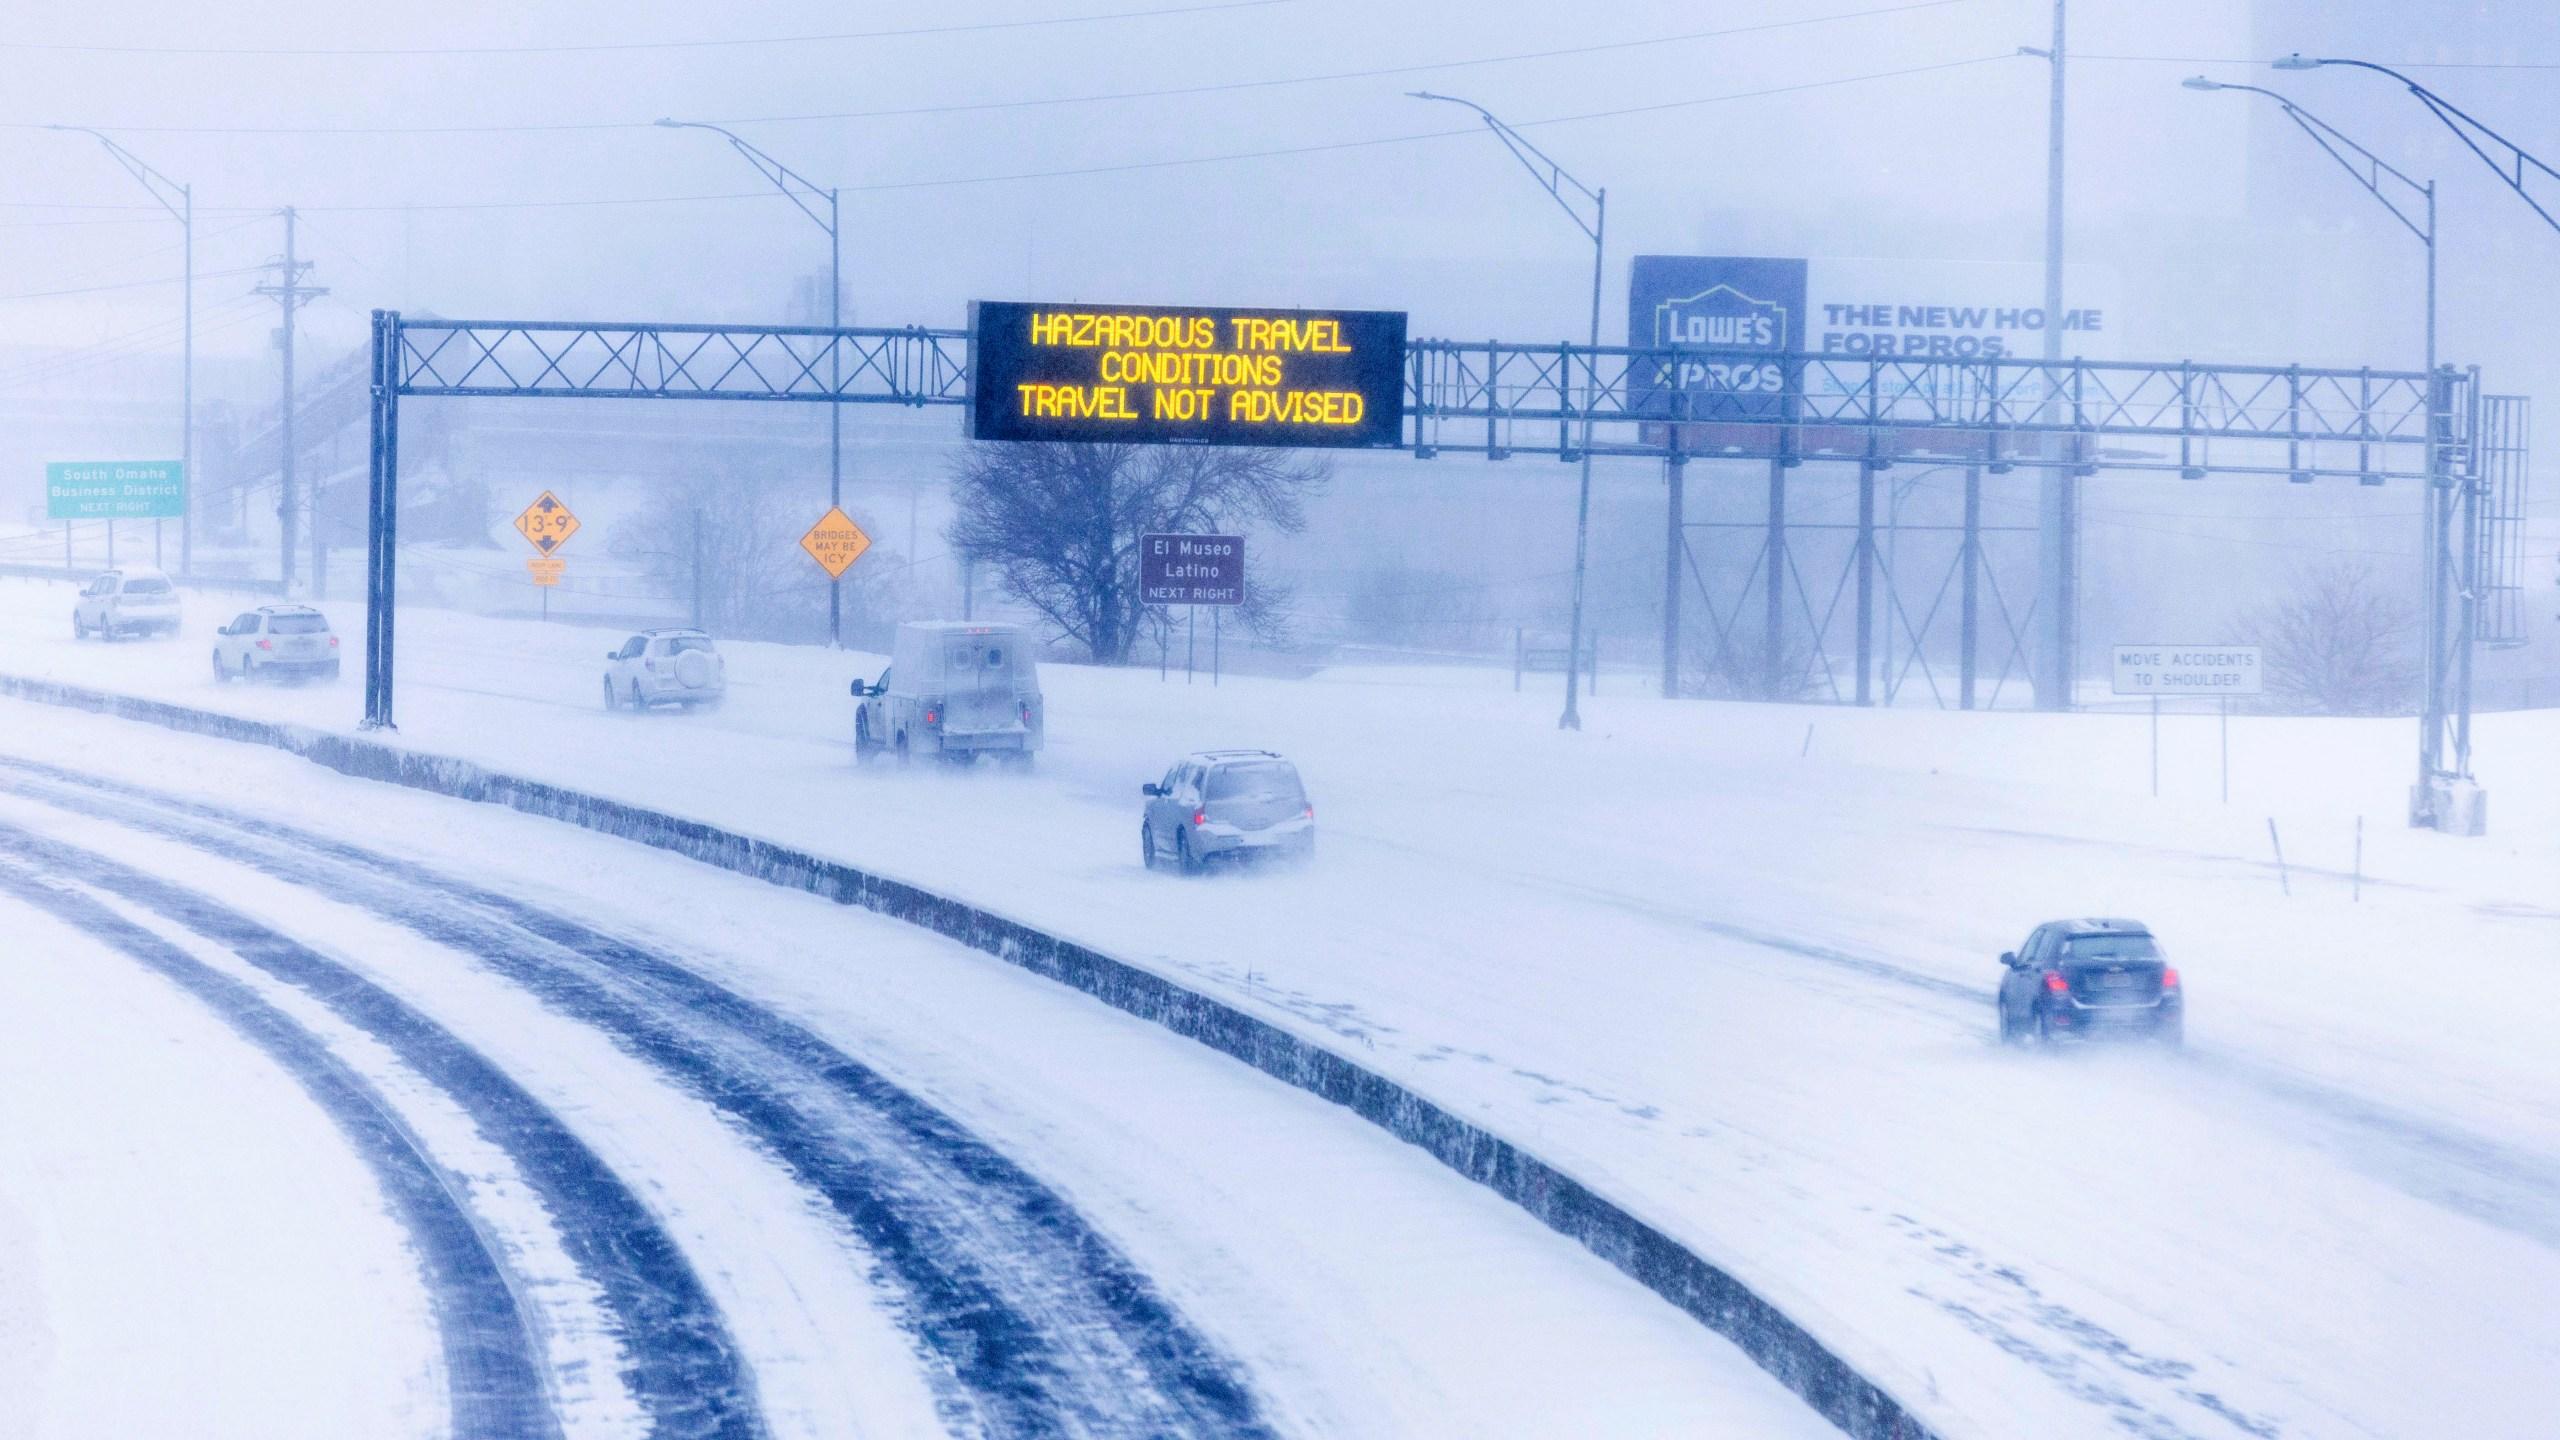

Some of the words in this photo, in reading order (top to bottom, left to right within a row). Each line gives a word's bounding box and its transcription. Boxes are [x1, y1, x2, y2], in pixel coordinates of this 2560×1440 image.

[1823, 303, 1892, 327] THE
[1898, 306, 1989, 329] NEW
[1031, 313, 1215, 348] HAZARDOUS
[1231, 318, 1352, 352] TRAVEL
[1669, 310, 1772, 345] LOWE'S
[1823, 333, 1897, 356] FOR
[1904, 335, 2014, 358] PROS.
[1101, 351, 1282, 385] CONDITIONS
[1679, 363, 1784, 392] PROS
[1017, 384, 1138, 419] TRAVEL
[1154, 388, 1215, 421] NOT
[1230, 390, 1363, 424] ADVISED
[63, 468, 107, 480] South
[115, 467, 167, 480] Omaha
[53, 486, 115, 497] Business
[123, 483, 178, 497] District
[80, 502, 112, 512] NEXT
[116, 501, 151, 512] RIGHT
[814, 530, 858, 540] BRIDGES
[816, 542, 837, 551] MAY
[843, 542, 856, 551] BE
[1154, 540, 1169, 555] El
[1180, 540, 1232, 556] Museo
[825, 553, 847, 563] ICY
[1165, 562, 1219, 578] Latino
[1149, 587, 1185, 599] NEXT
[1193, 588, 1235, 600] RIGHT
[2120, 653, 2160, 665] MOVE
[2172, 653, 2254, 665] ACCIDENTS
[2135, 673, 2152, 685] TO
[2162, 673, 2241, 685] SHOULDER
